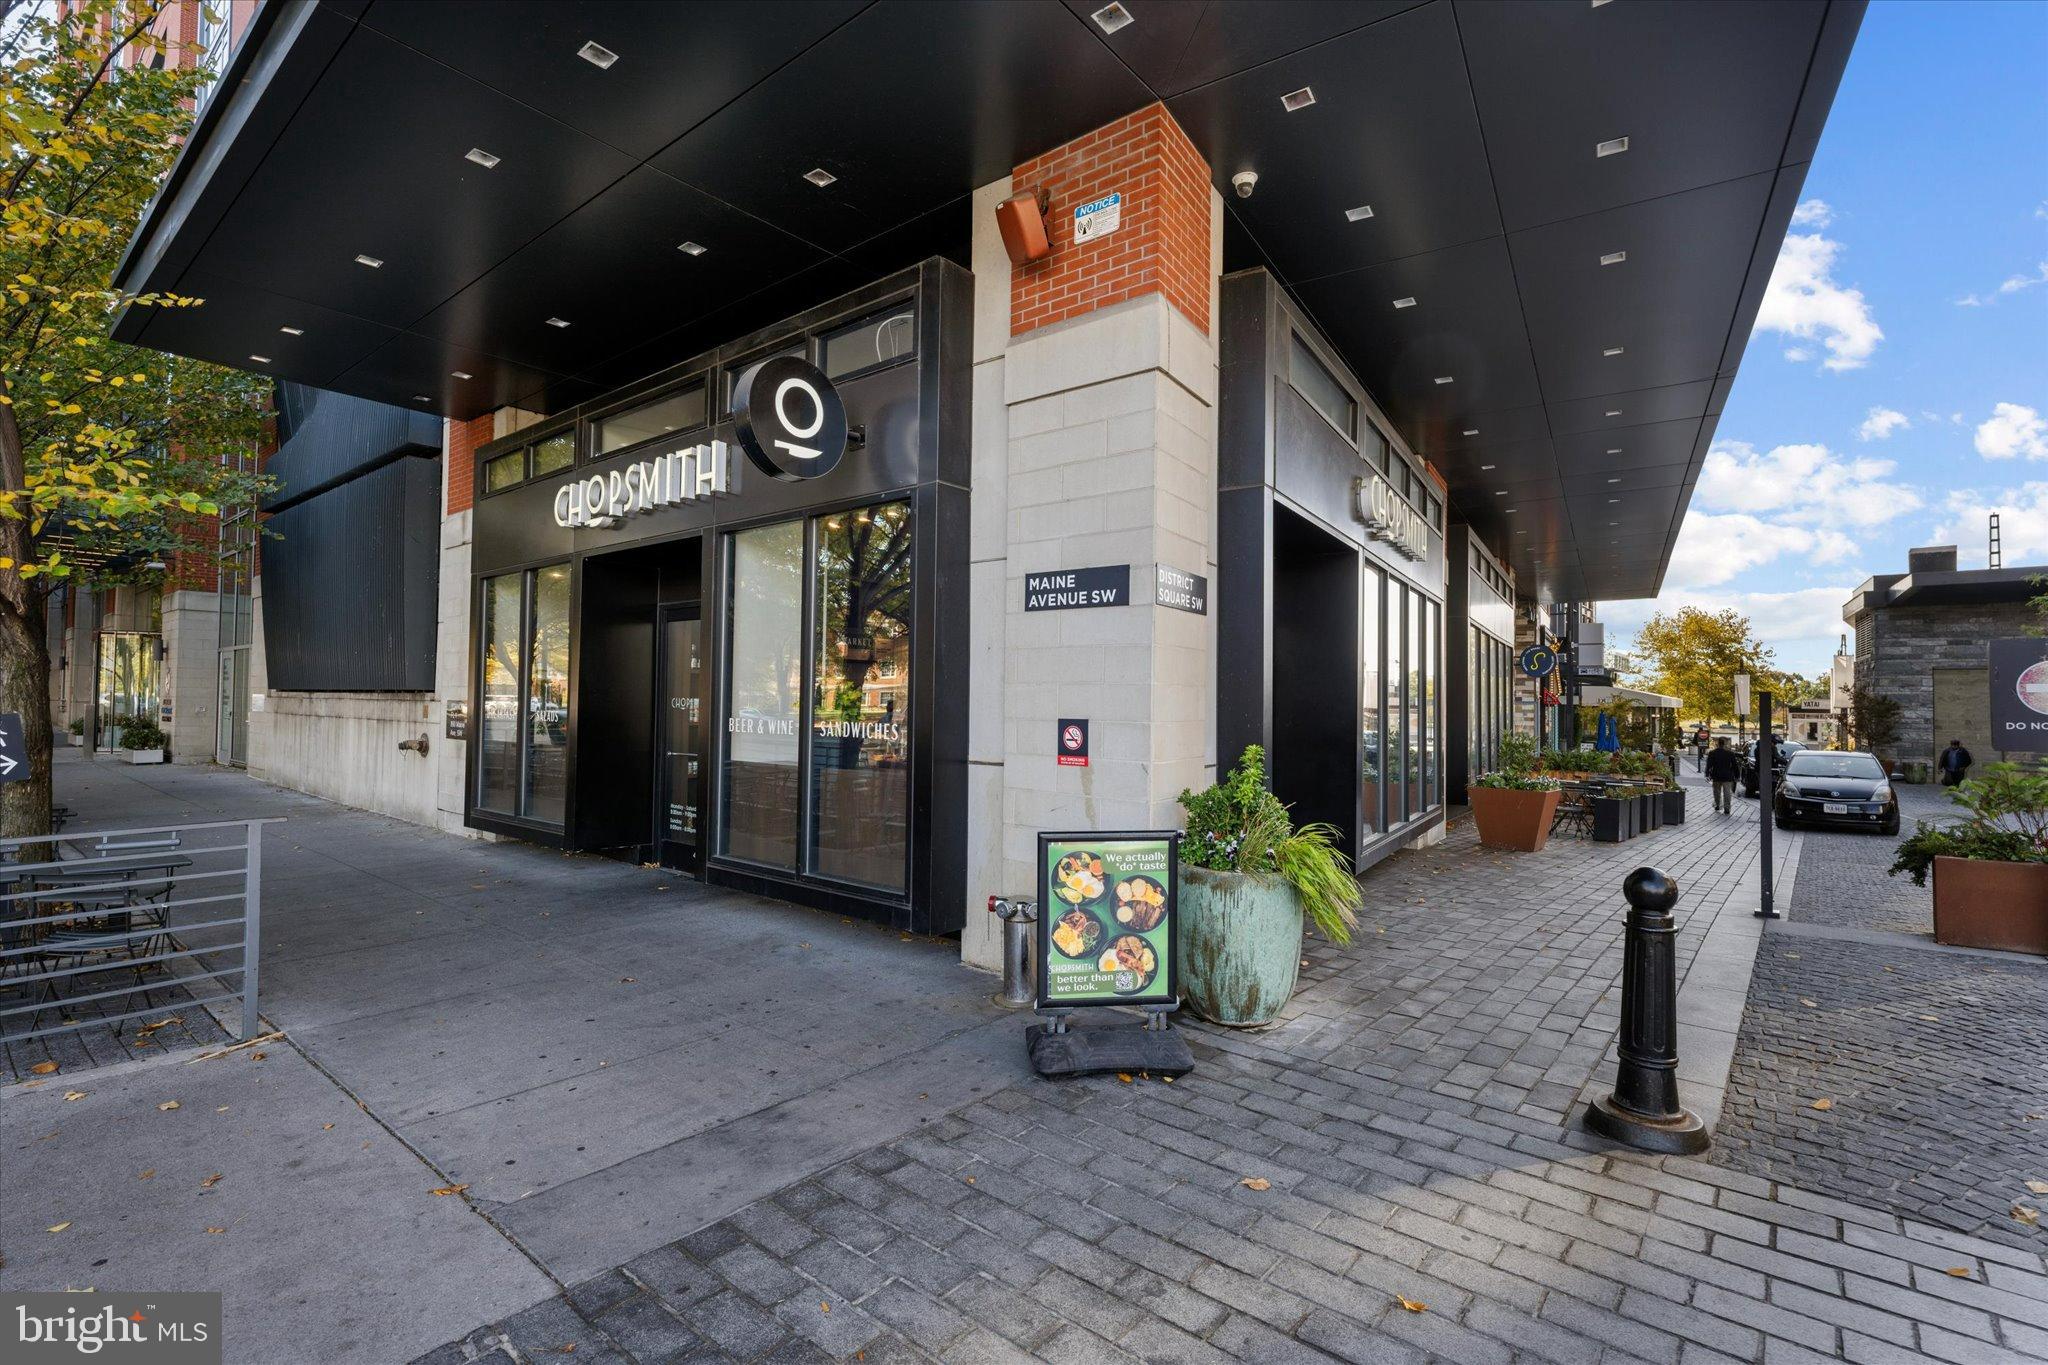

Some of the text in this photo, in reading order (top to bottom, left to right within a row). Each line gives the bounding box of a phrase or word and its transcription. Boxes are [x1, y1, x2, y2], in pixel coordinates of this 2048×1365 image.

[1080, 196, 1115, 216] NOTICE
[554, 439, 727, 528] CHOPSMITH
[1029, 574, 1076, 590] MAINE
[1158, 569, 1194, 591] DISTRICT
[1028, 589, 1116, 607] AVENUE SW
[1158, 588, 1203, 611] SQUARE SW
[535, 711, 559, 723] SALADS
[729, 717, 794, 735] BEER & WINE
[819, 721, 899, 741] SANDWICHES
[2005, 722, 2027, 730] DO
[1105, 852, 1167, 862] We actually
[1140, 862, 1166, 870] taste
[1051, 963, 1094, 972] CHOPSMITH
[1057, 973, 1114, 984] better than
[1074, 983, 1098, 991] look.
